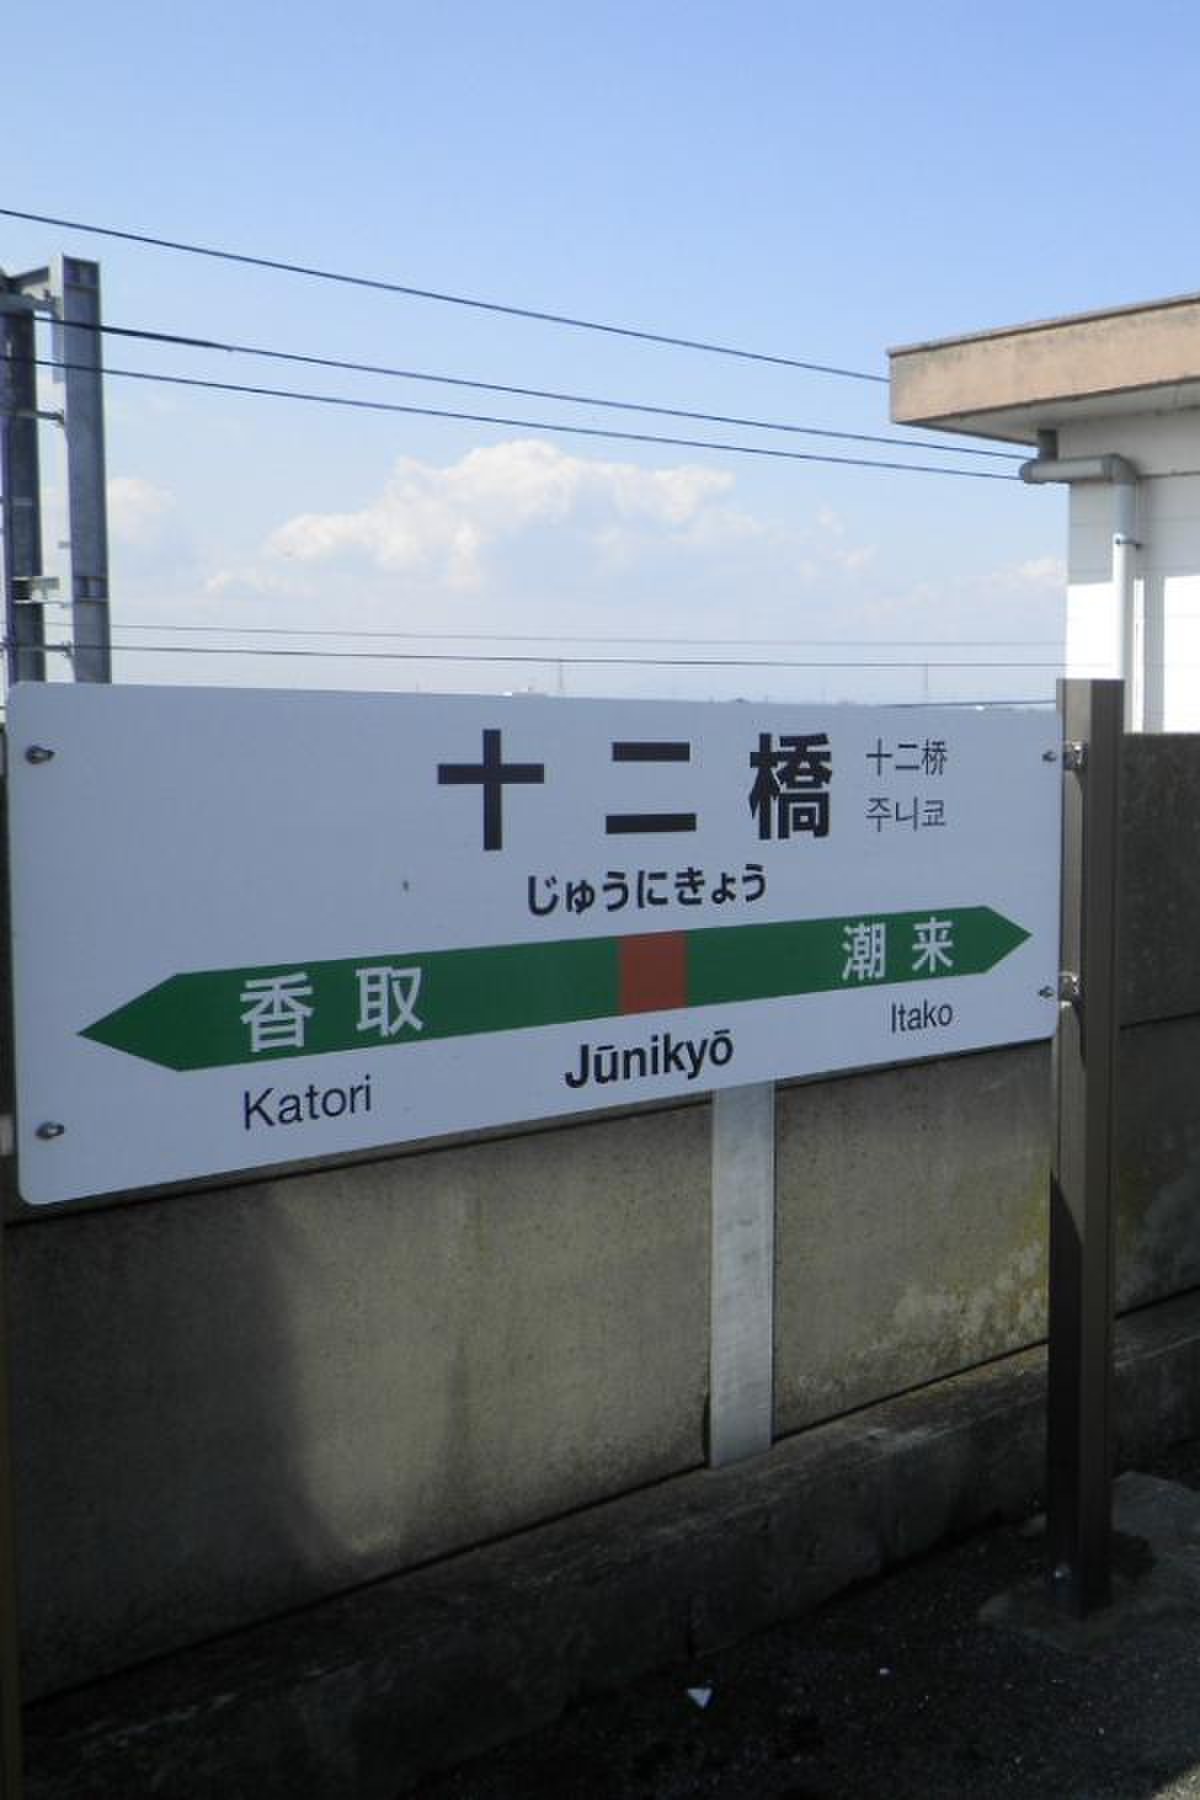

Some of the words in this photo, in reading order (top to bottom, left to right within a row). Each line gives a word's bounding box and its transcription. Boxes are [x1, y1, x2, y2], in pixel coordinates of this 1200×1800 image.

[866, 738, 947, 775] 十二桥
[437, 729, 832, 851] 十二橋
[866, 797, 946, 832] 주니쿄
[528, 865, 764, 915] じゅうにきょう
[842, 917, 953, 980] 潮来
[240, 965, 424, 1052] 香取
[890, 1001, 952, 1033] Itako
[565, 1030, 734, 1088] Jūnikyō
[243, 1074, 371, 1130] Katori
